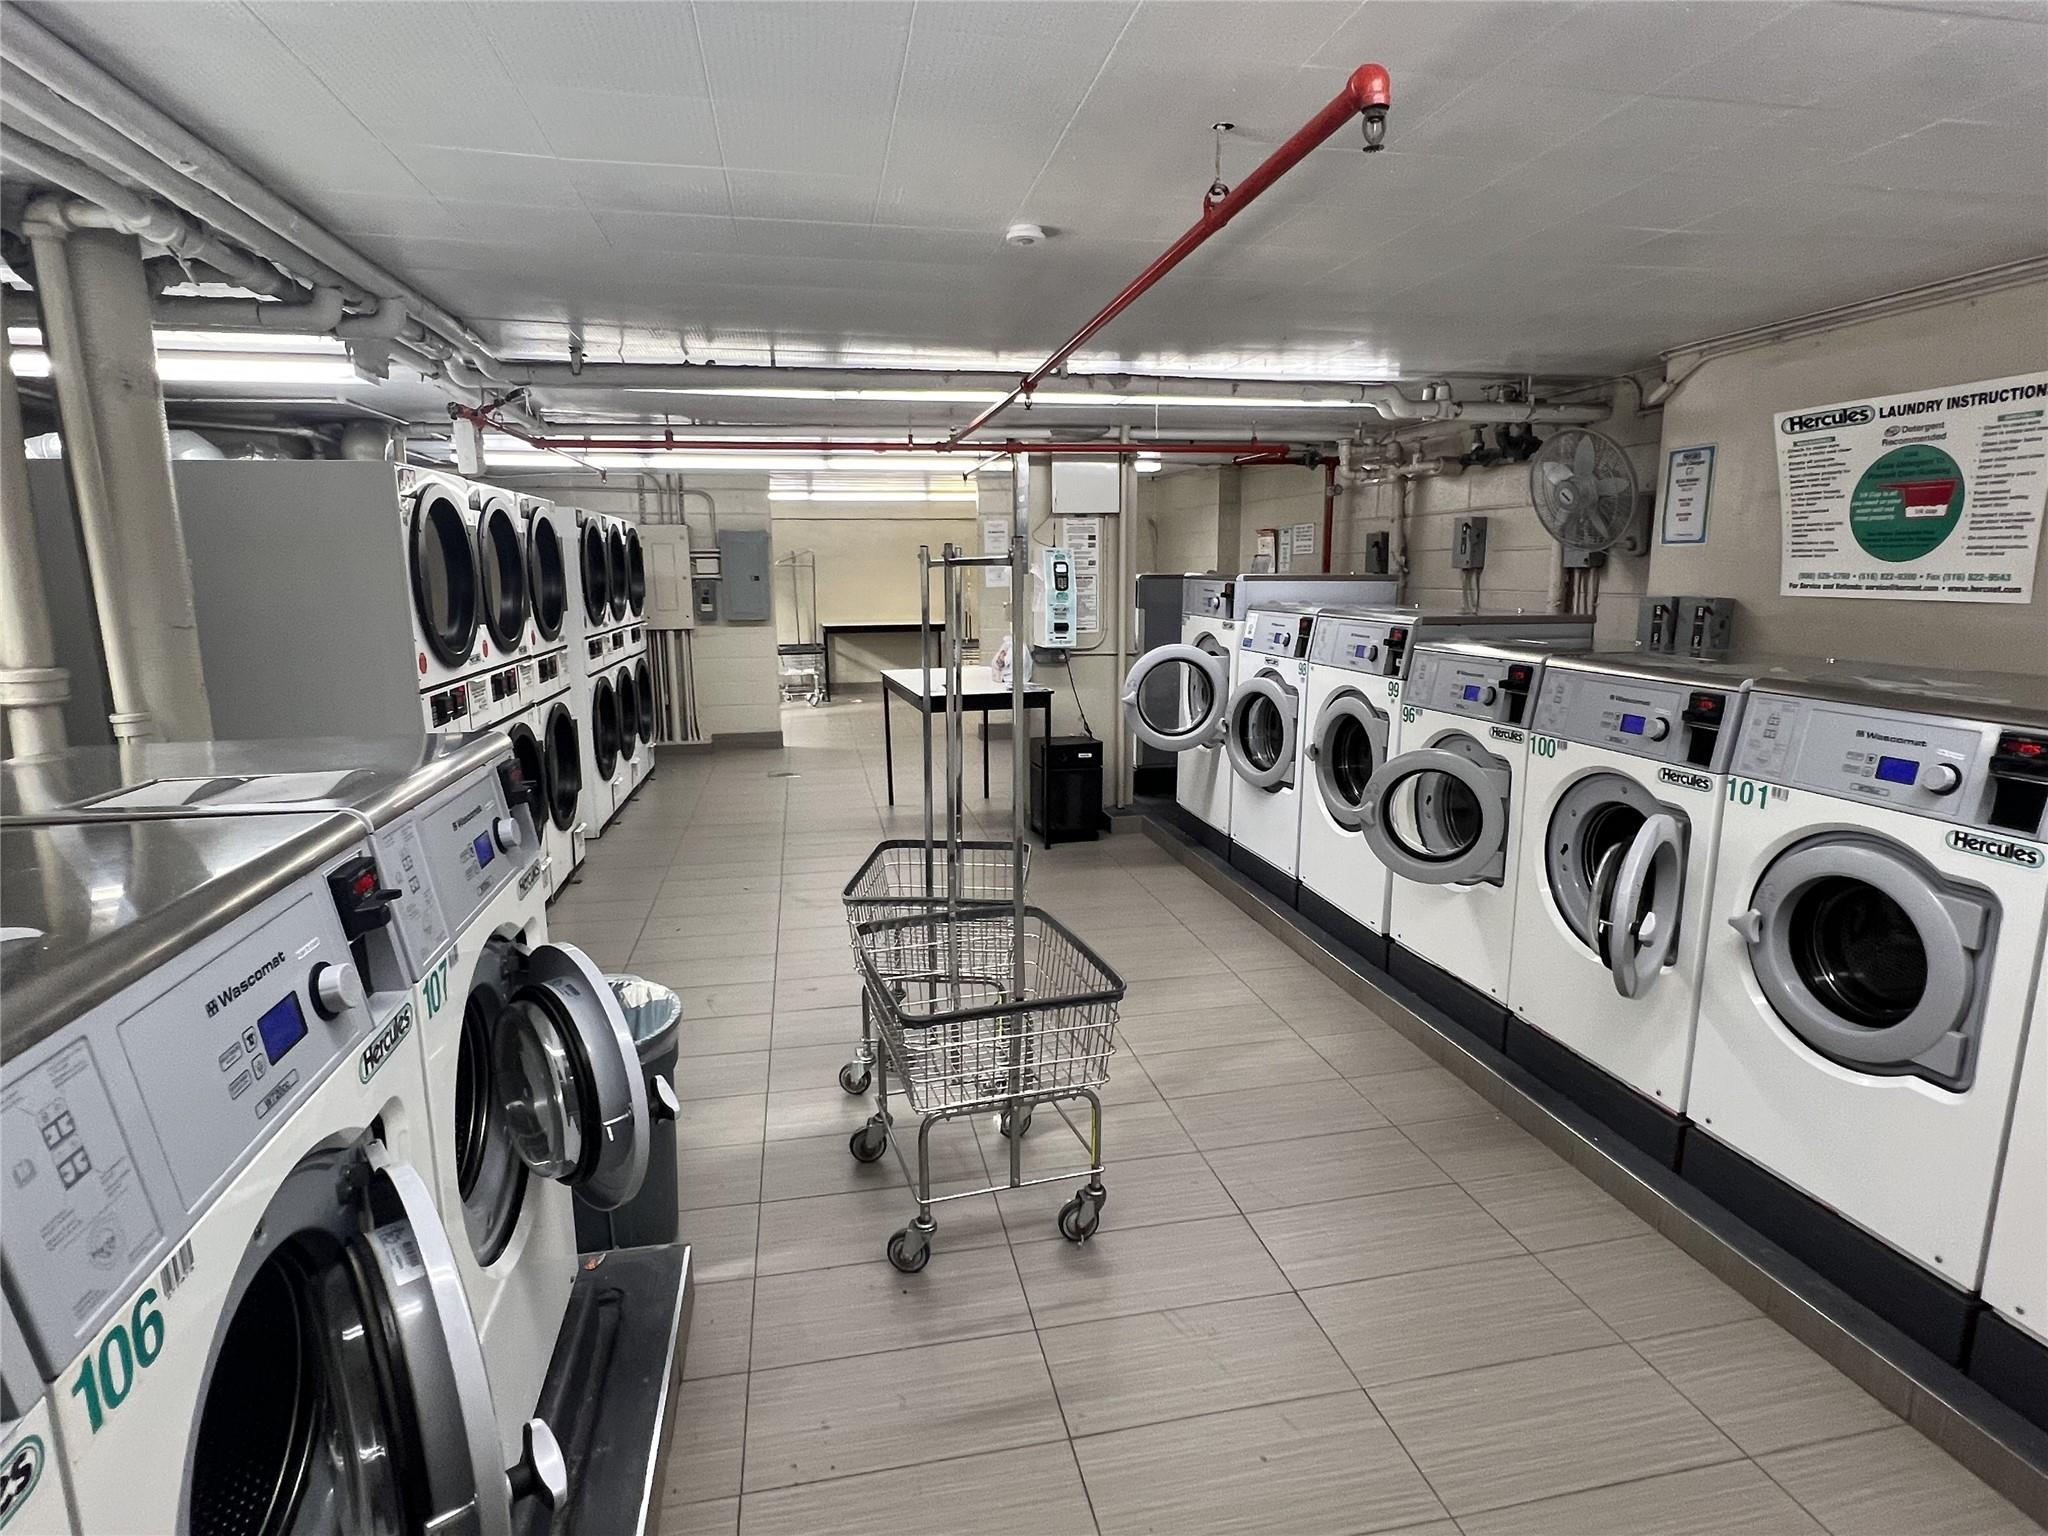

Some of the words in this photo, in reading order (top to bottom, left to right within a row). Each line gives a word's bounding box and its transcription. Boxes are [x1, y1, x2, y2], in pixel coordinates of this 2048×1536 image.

[1789, 409, 1869, 432] Hercules
[1879, 399, 1943, 418] LAUNDRY
[1902, 422, 1945, 433] Detergent
[1882, 433, 1947, 446] Recommended
[1388, 681, 1399, 698] 99
[1402, 706, 1415, 723] 96
[1530, 736, 1556, 758] 100
[1866, 731, 1928, 747] Wascomat
[1662, 768, 1709, 790] Hercules
[1728, 778, 1768, 810] 101
[1953, 830, 2038, 865] Hercules
[217, 951, 286, 1008] Wascomat
[422, 957, 448, 1020] 107
[362, 1009, 410, 1076] Hercules
[71, 1287, 164, 1435] 106
